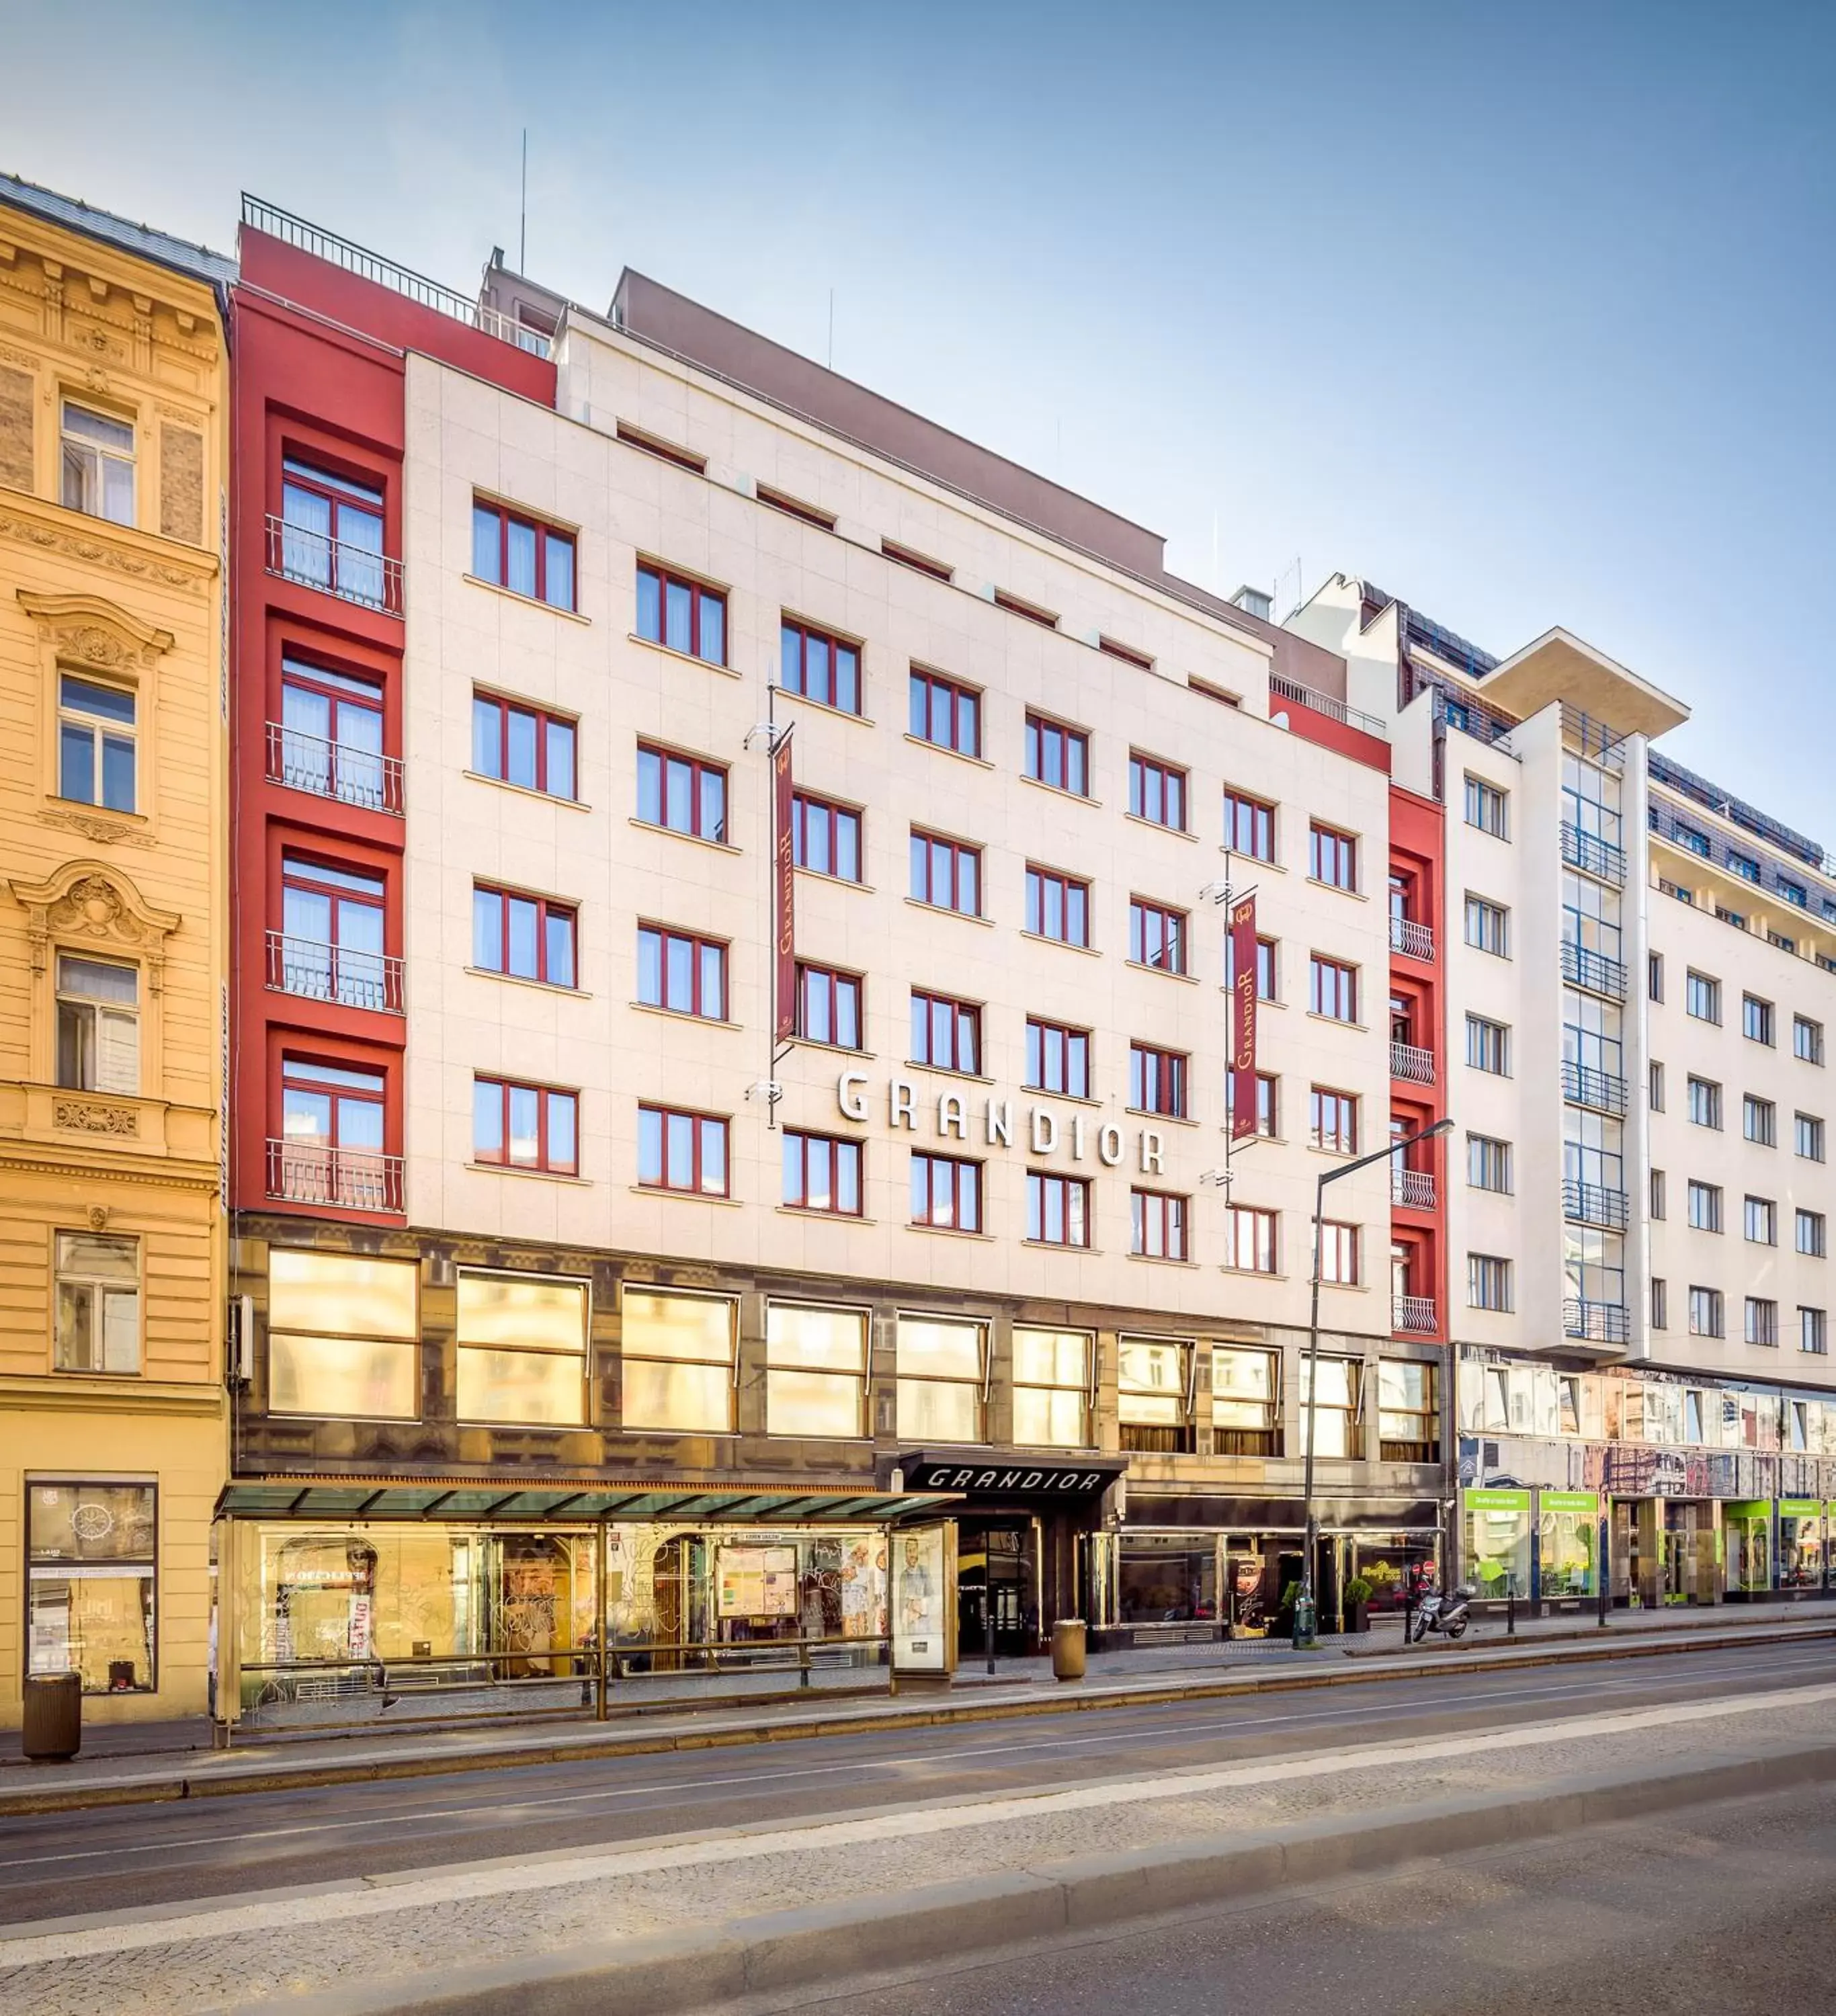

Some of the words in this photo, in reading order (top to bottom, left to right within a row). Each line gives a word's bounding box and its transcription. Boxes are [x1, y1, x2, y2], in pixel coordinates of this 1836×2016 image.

[1237, 967, 1254, 1070] GRANDIOR
[839, 1070, 1165, 1175] GRANDIOR
[928, 1469, 1101, 1490] GRANDIOR
